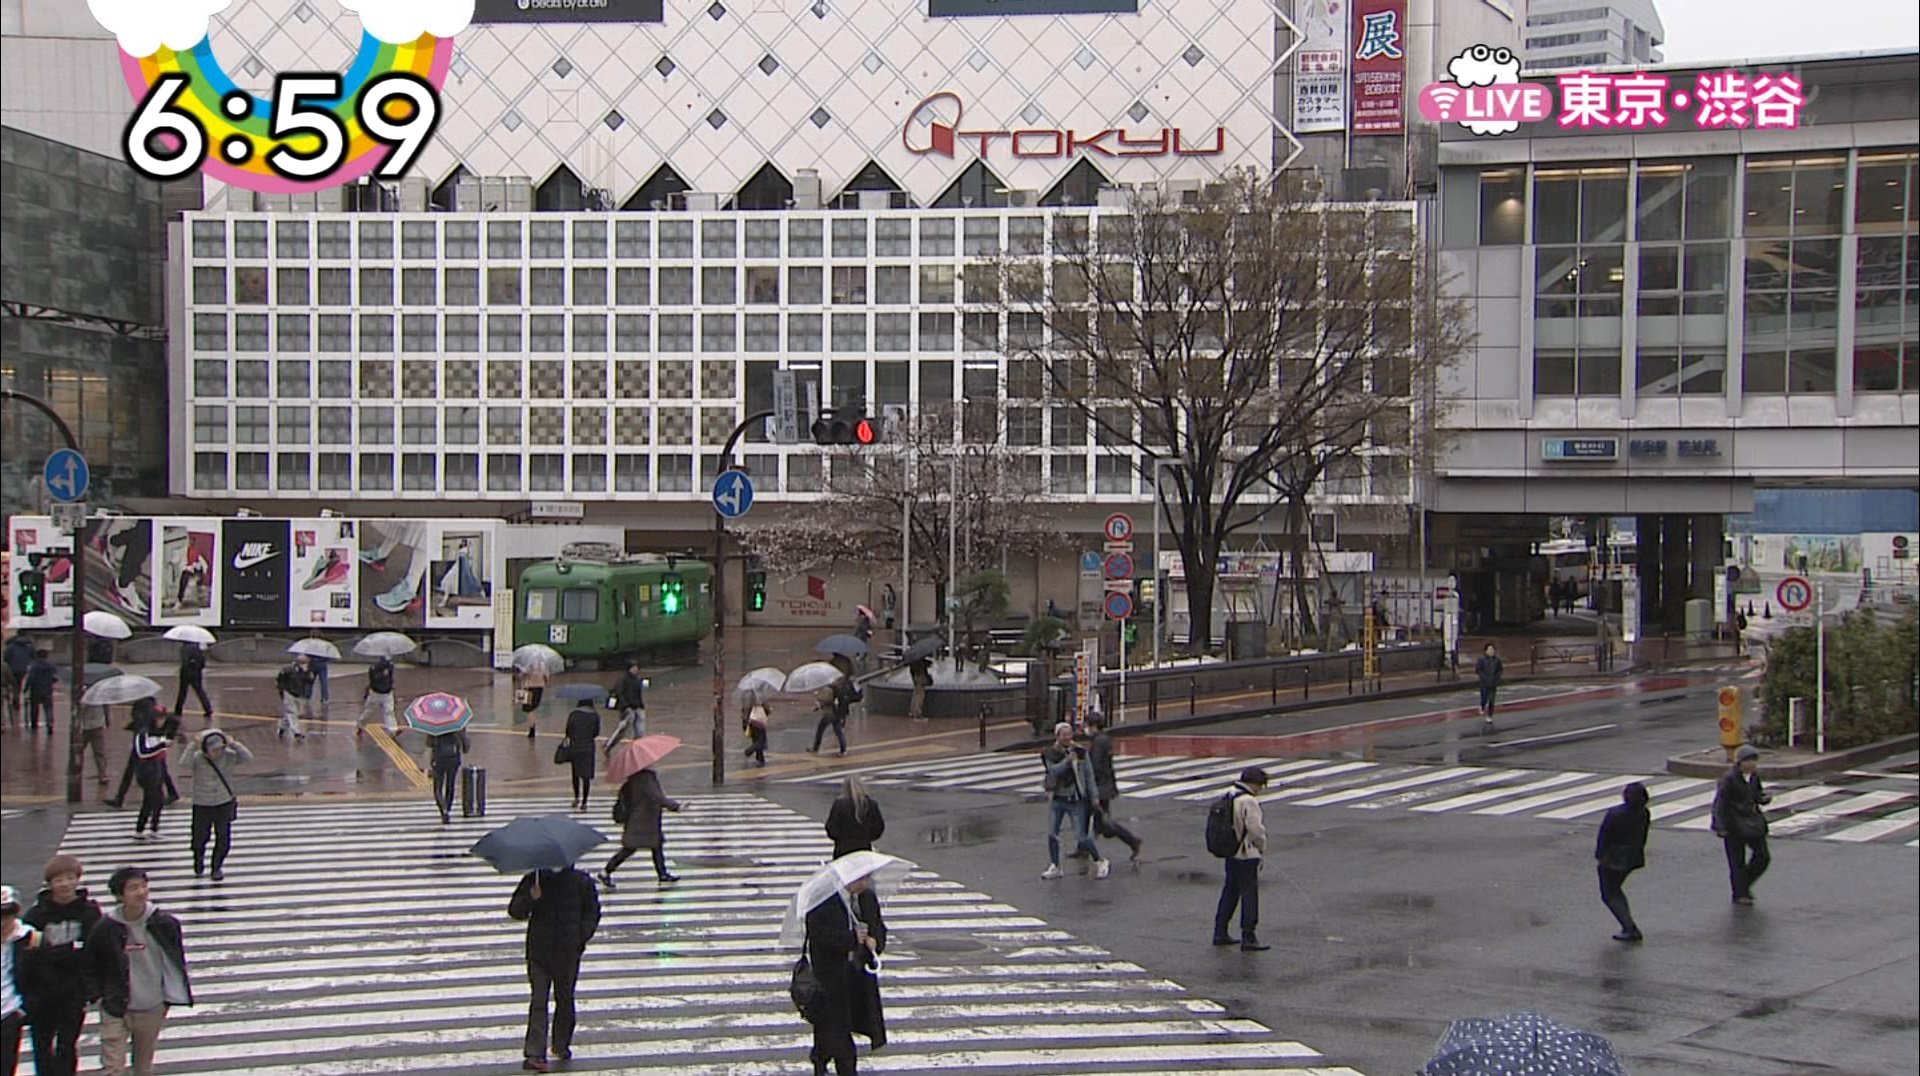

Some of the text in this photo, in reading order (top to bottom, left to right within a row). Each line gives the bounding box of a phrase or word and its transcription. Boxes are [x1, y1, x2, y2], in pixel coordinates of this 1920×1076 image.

[1356, 10, 1402, 59] 展
[958, 126, 1224, 159] TOKYU
[241, 542, 273, 557] NIKE
